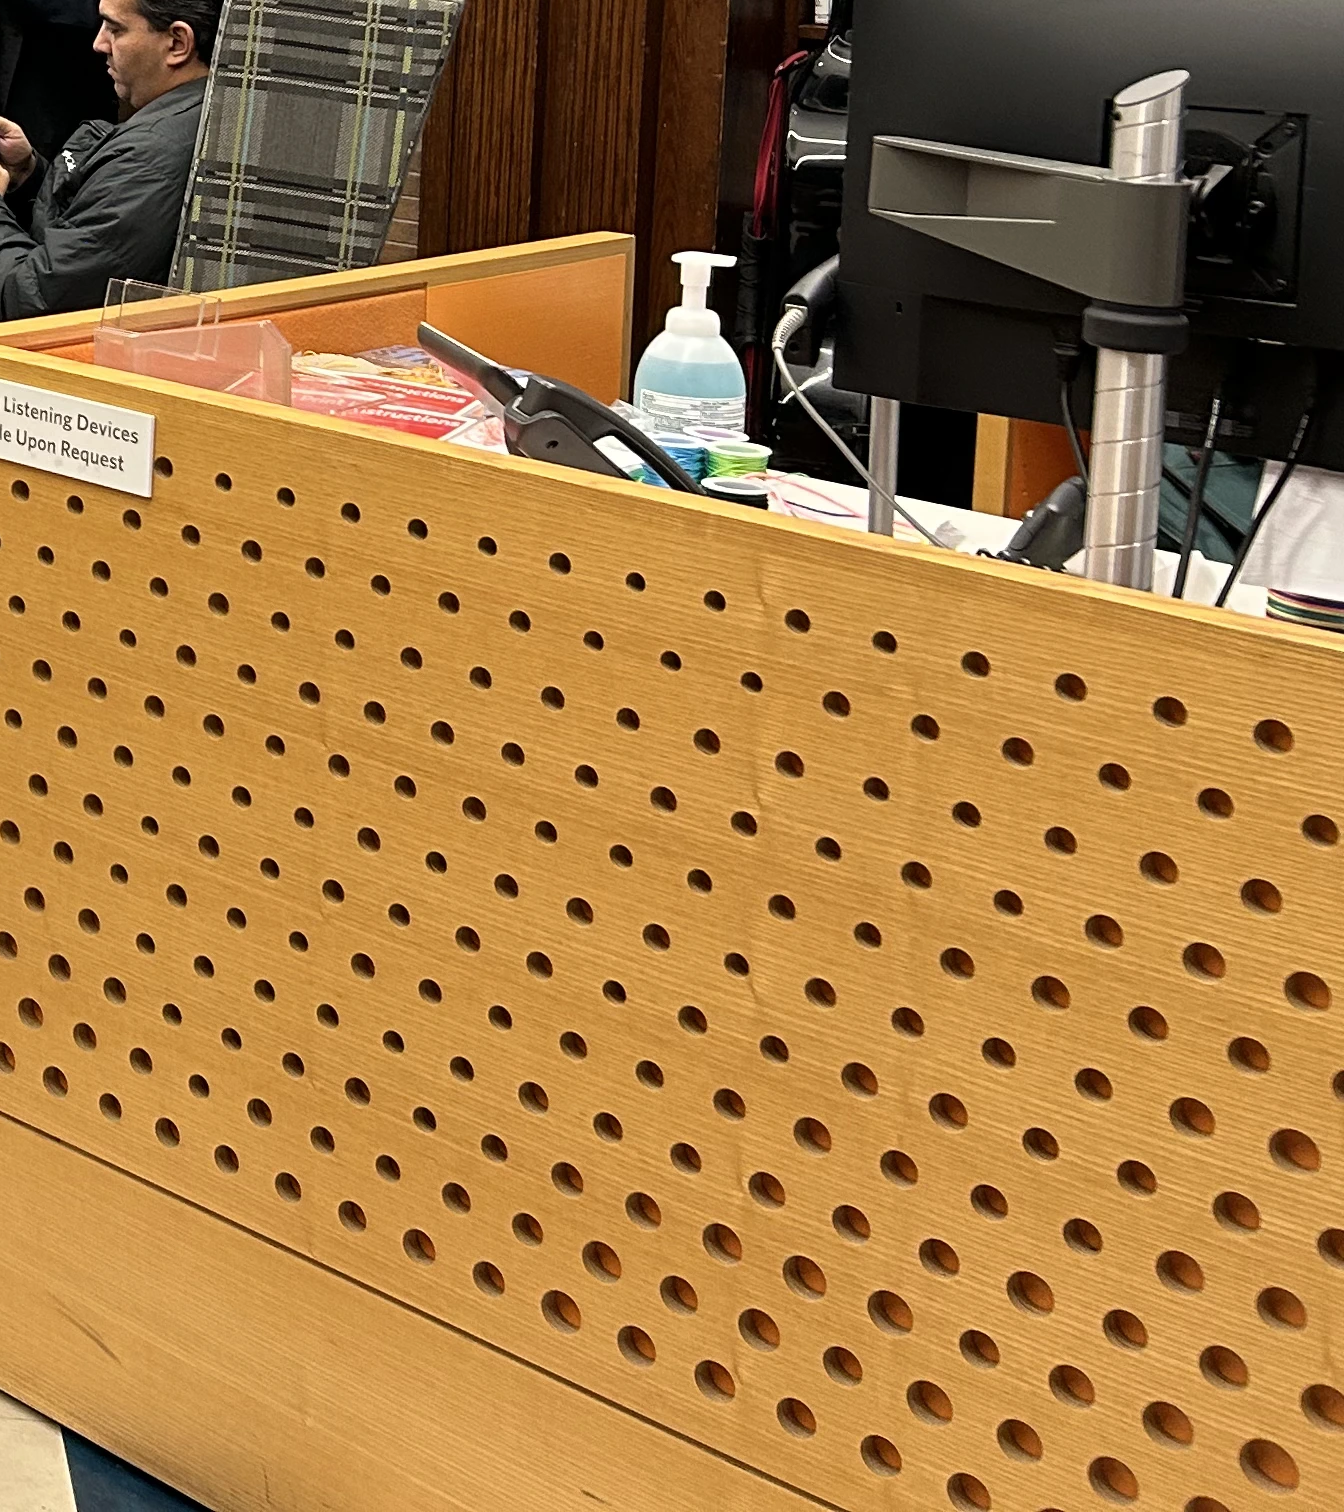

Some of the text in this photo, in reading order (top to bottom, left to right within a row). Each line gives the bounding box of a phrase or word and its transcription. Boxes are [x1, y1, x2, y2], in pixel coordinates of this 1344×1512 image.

[3, 395, 73, 431] Listening
[77, 413, 139, 444] Devices
[15, 428, 56, 454] Upon
[60, 440, 124, 472] Request
